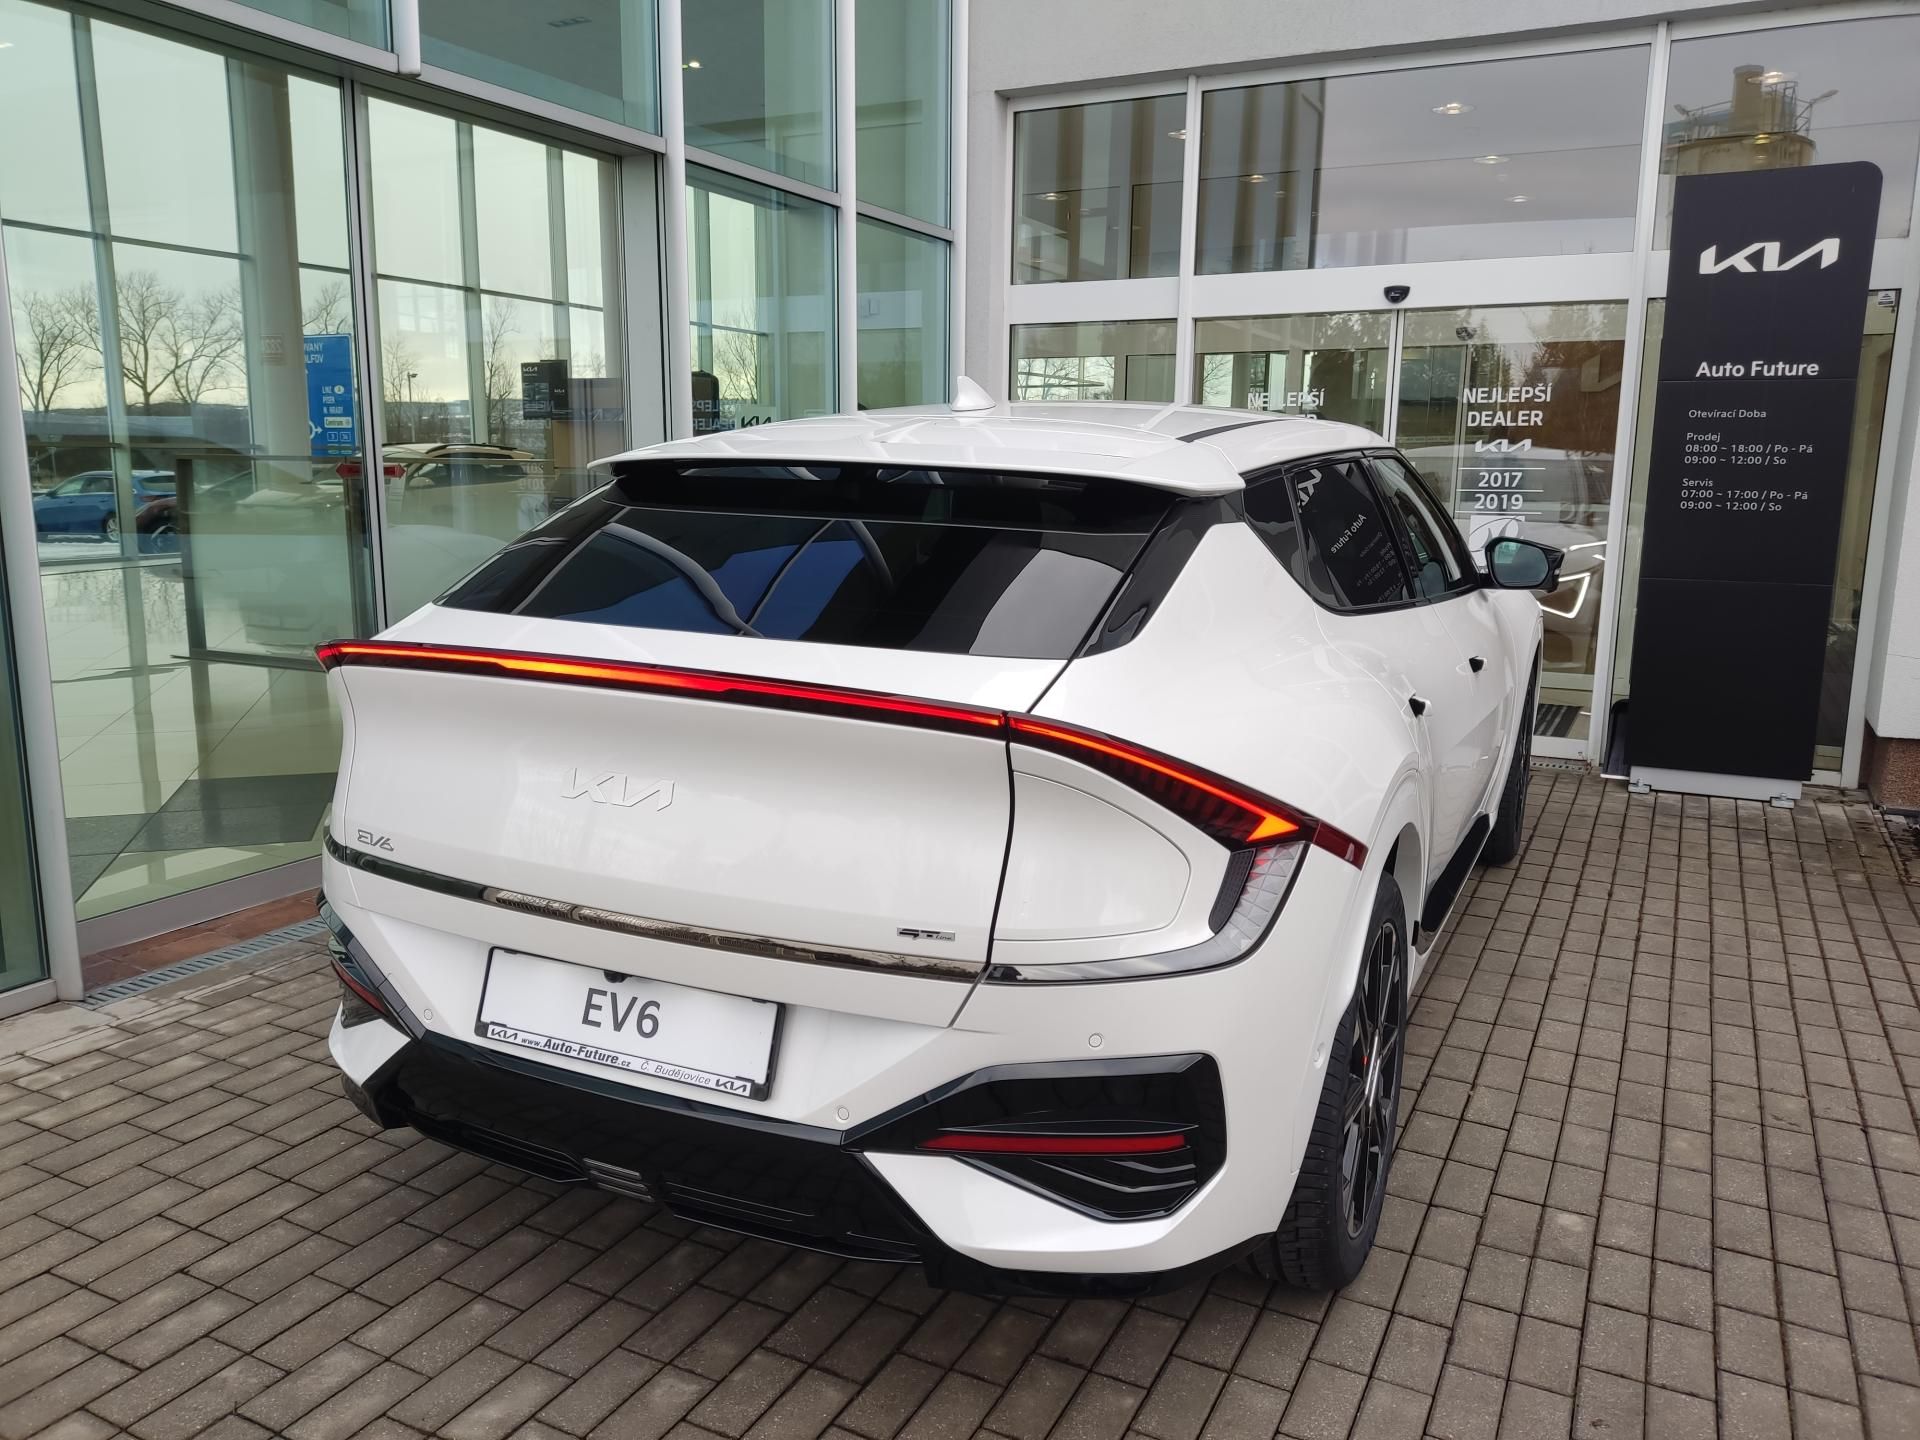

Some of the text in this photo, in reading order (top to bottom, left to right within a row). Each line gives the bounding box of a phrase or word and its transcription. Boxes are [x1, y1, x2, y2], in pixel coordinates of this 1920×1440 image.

[1698, 237, 1840, 275] KIA
[1695, 360, 1820, 378] Auto Future
[1462, 383, 1552, 404] NEJLEPŠÍ
[1467, 410, 1544, 427] DEALER
[1688, 409, 1767, 418] Otevírací Doba
[1686, 432, 1721, 443] Prodej
[1685, 444, 1718, 453] 08:00
[1731, 444, 1763, 453] 18:00
[1774, 445, 1788, 453] Po
[1799, 445, 1813, 453] Pá
[1684, 455, 1716, 464] 09:00
[1731, 456, 1762, 465] 12:00
[1773, 456, 1786, 465] So
[1478, 471, 1523, 488] 2017
[1682, 478, 1713, 487] Servis
[1474, 493, 1523, 510] 2019
[1681, 489, 1713, 498] 07:00
[1727, 490, 1759, 499] 17:00
[1769, 491, 1783, 499] Po
[1794, 491, 1808, 500] Pá
[1680, 501, 1712, 509] 09:00
[1726, 502, 1758, 510] 12:00
[1768, 502, 1782, 511] So
[357, 828, 394, 851] EV6
[581, 987, 661, 1039] EV6
[521, 1038, 631, 1068] www.Auto-Future.cz
[654, 1064, 711, 1086] Budějovice
